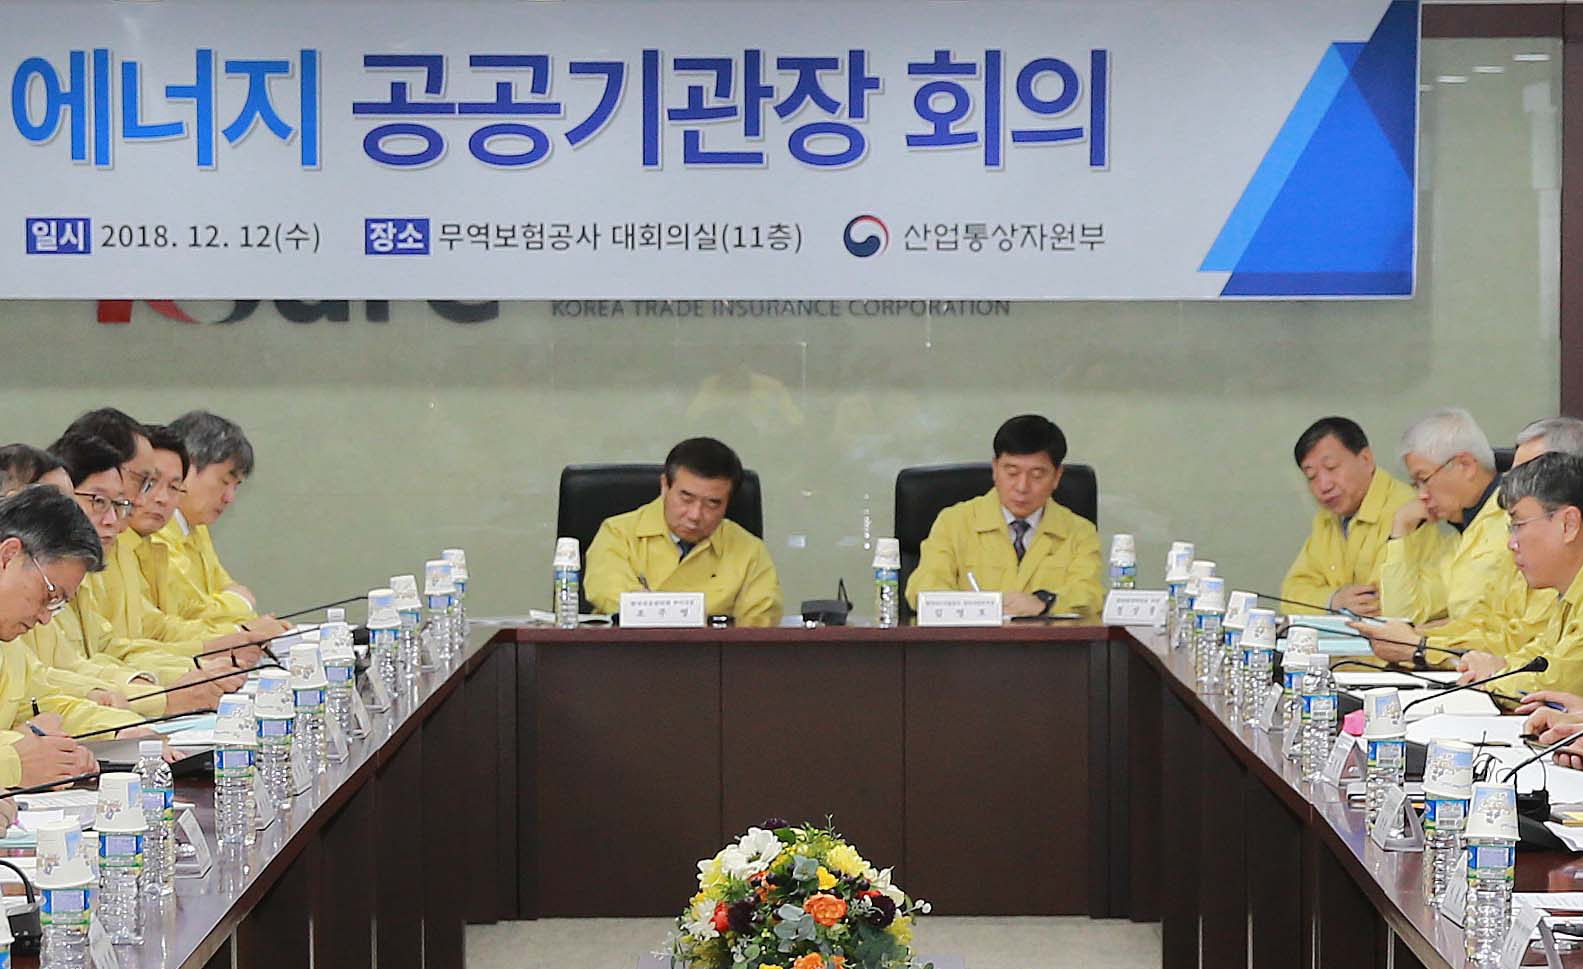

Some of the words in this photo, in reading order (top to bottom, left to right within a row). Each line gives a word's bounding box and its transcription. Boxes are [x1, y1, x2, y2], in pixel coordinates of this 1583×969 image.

[11, 48, 319, 168] 에너지
[352, 48, 882, 168] 공공기관장
[904, 48, 1108, 168] 회의
[30, 220, 87, 251] 일시
[100, 223, 177, 249] 2018.
[189, 223, 229, 249] 12.
[239, 222, 321, 253] 12(수)
[368, 220, 427, 252] 장소
[438, 221, 601, 252] 무역보험공사
[611, 221, 803, 253] 대회의실(11층)
[903, 221, 1106, 252] 산업통상자원부
[551, 300, 624, 318] KOREA
[633, 300, 704, 318] TRADE
[715, 300, 841, 318] INSURANCE
[848, 300, 1011, 318] CORPORATION
